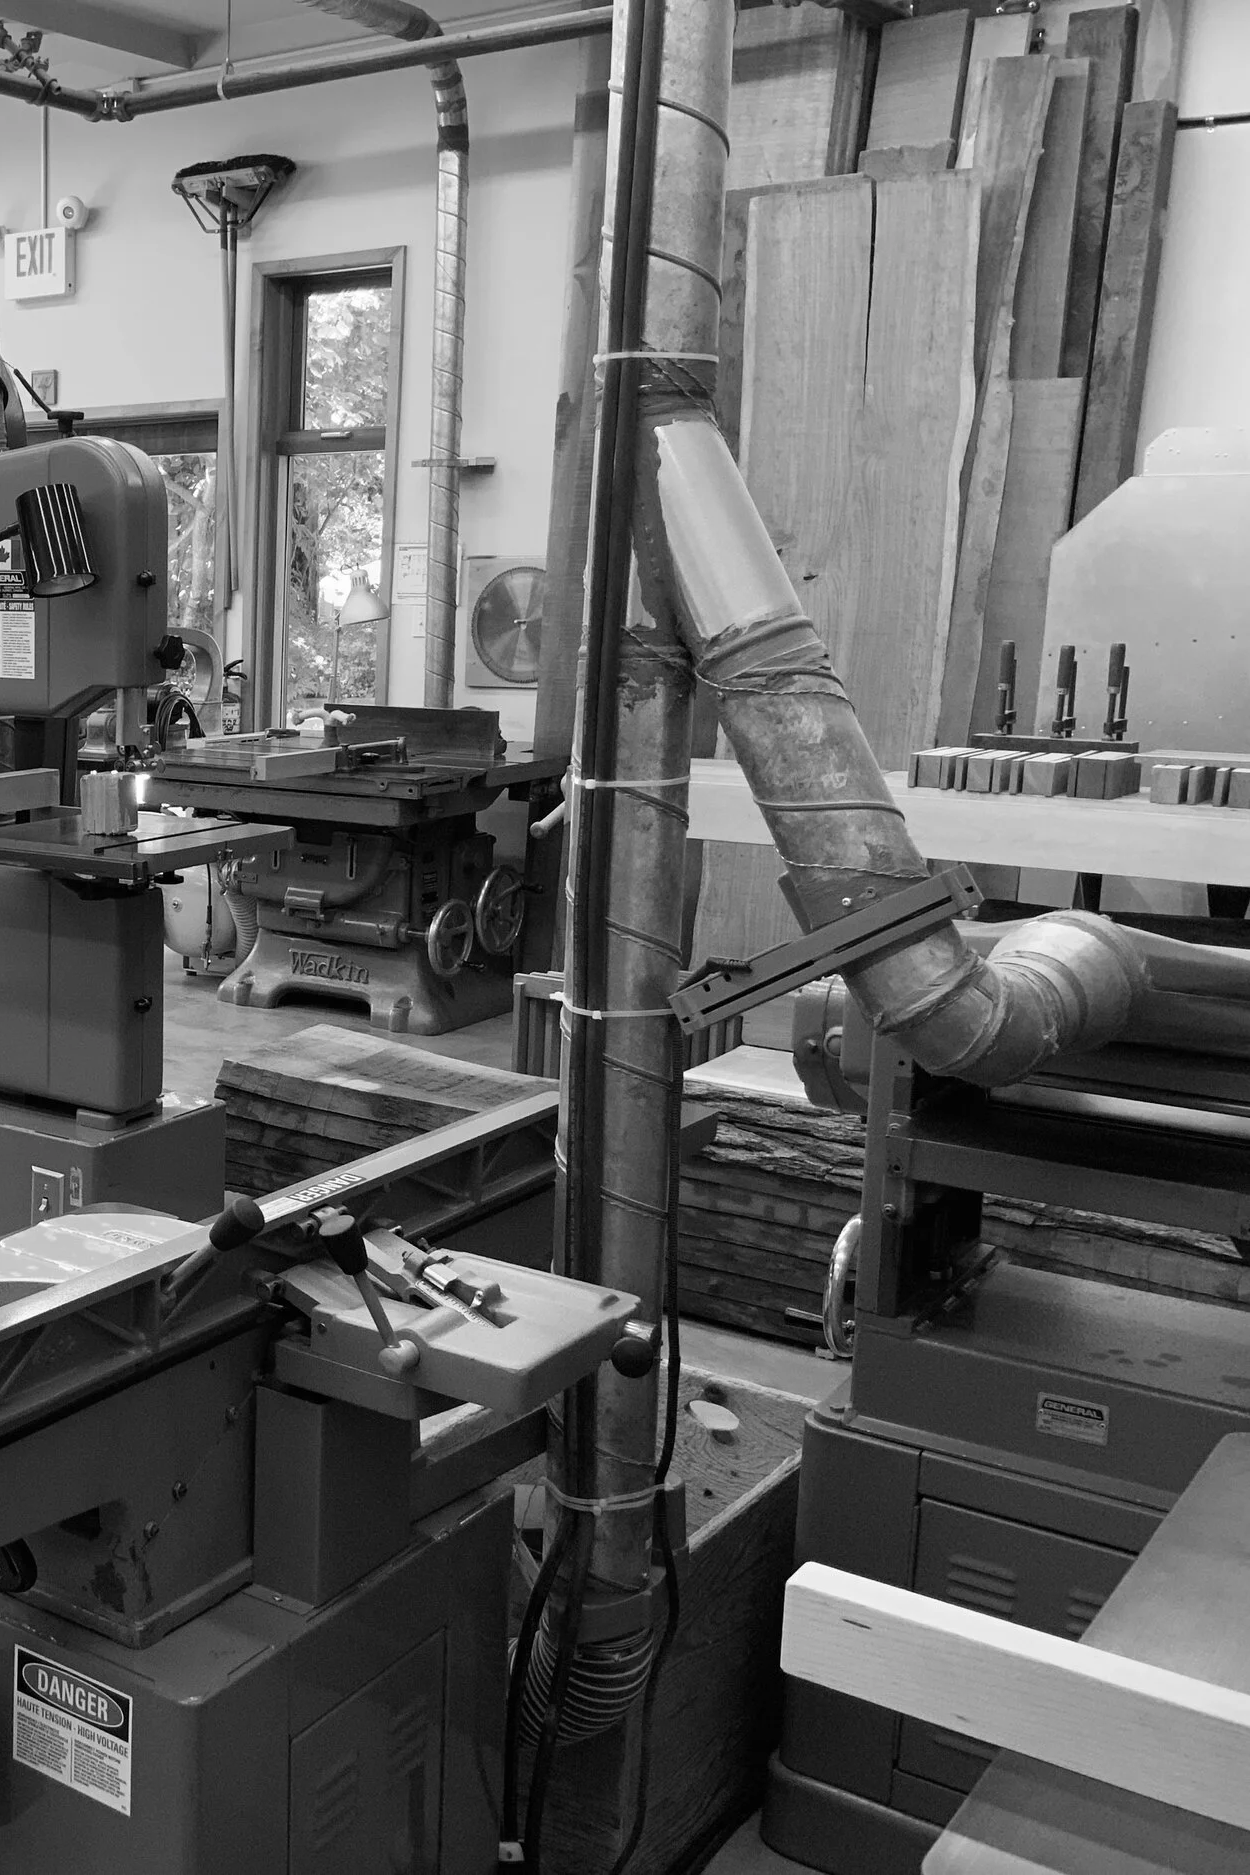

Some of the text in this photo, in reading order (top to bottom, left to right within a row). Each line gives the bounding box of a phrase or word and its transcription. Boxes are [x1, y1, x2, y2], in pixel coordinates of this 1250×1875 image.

[16, 233, 55, 277] EXIT
[290, 950, 370, 985] Wadkin
[289, 1172, 364, 1203] DANGER
[1043, 1400, 1103, 1420] GENERAL
[37, 1667, 109, 1723] DANGER
[16, 1695, 129, 1758] HAUTE TENSION HIGH VOLTAGE
